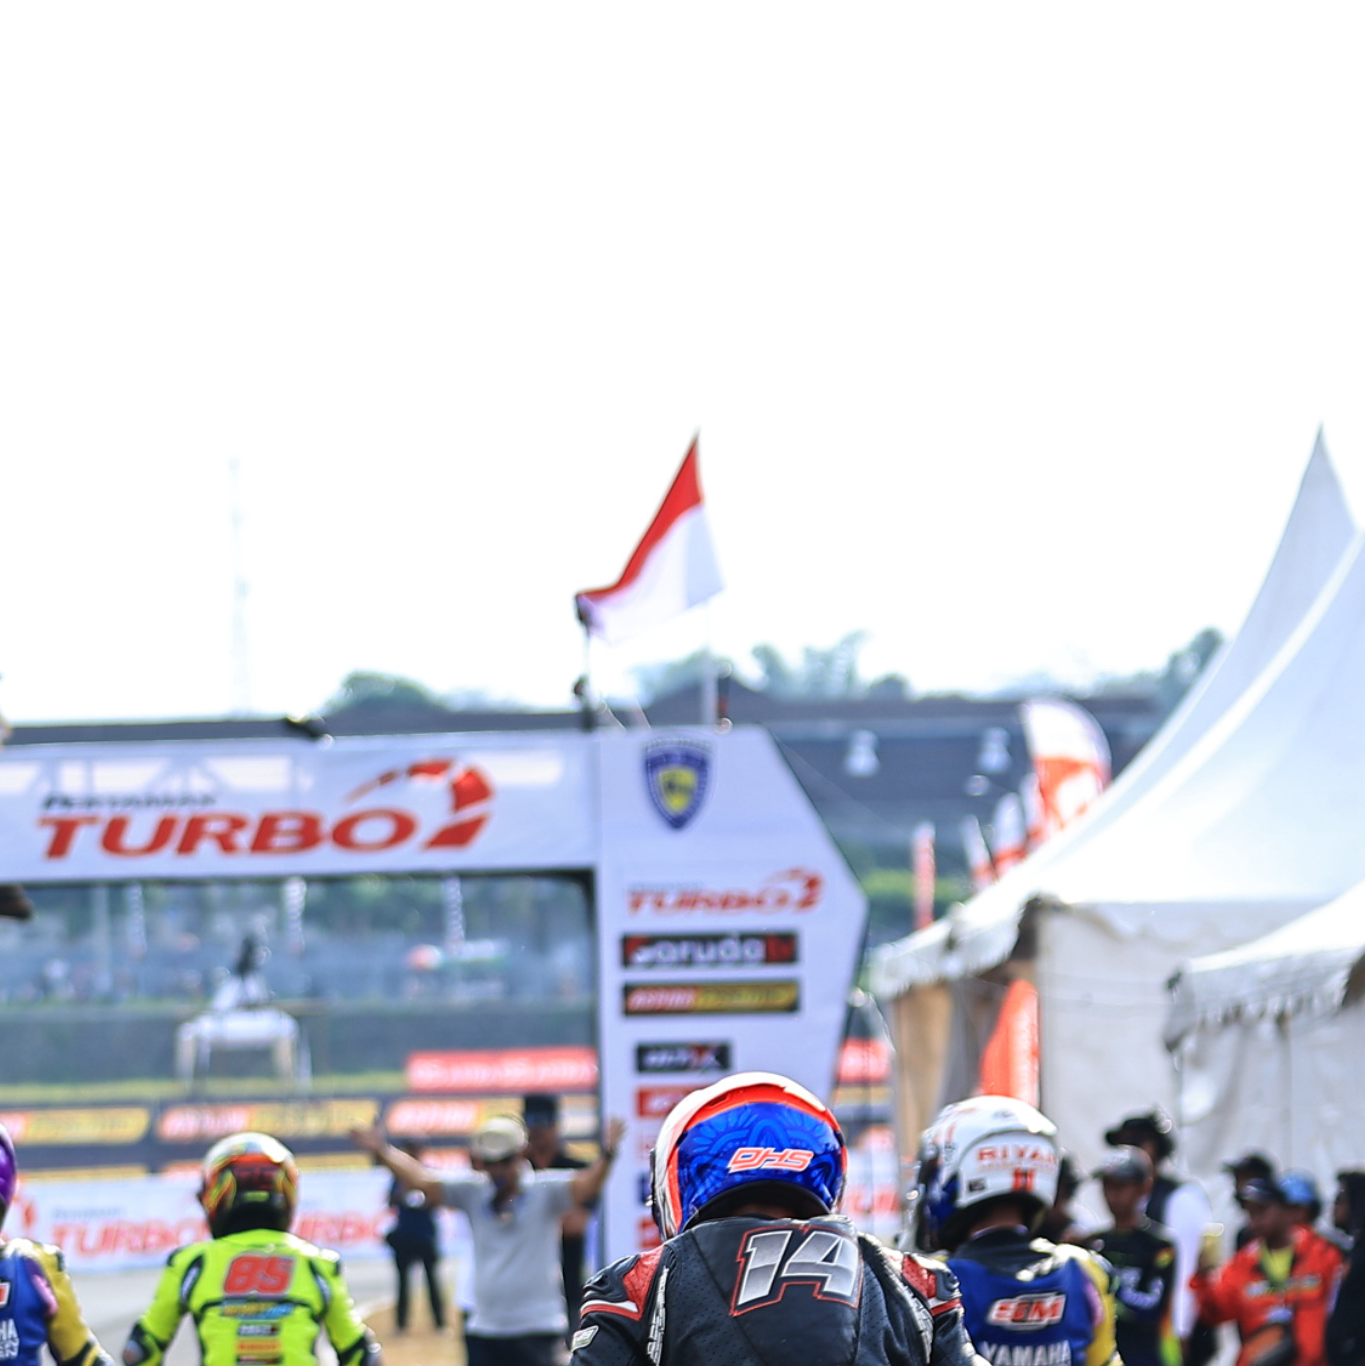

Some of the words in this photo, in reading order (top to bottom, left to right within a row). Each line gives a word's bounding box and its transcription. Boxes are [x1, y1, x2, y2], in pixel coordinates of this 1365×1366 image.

[37, 806, 418, 860] TURBO
[728, 1147, 815, 1173] DHS
[737, 1230, 863, 1306] 14
